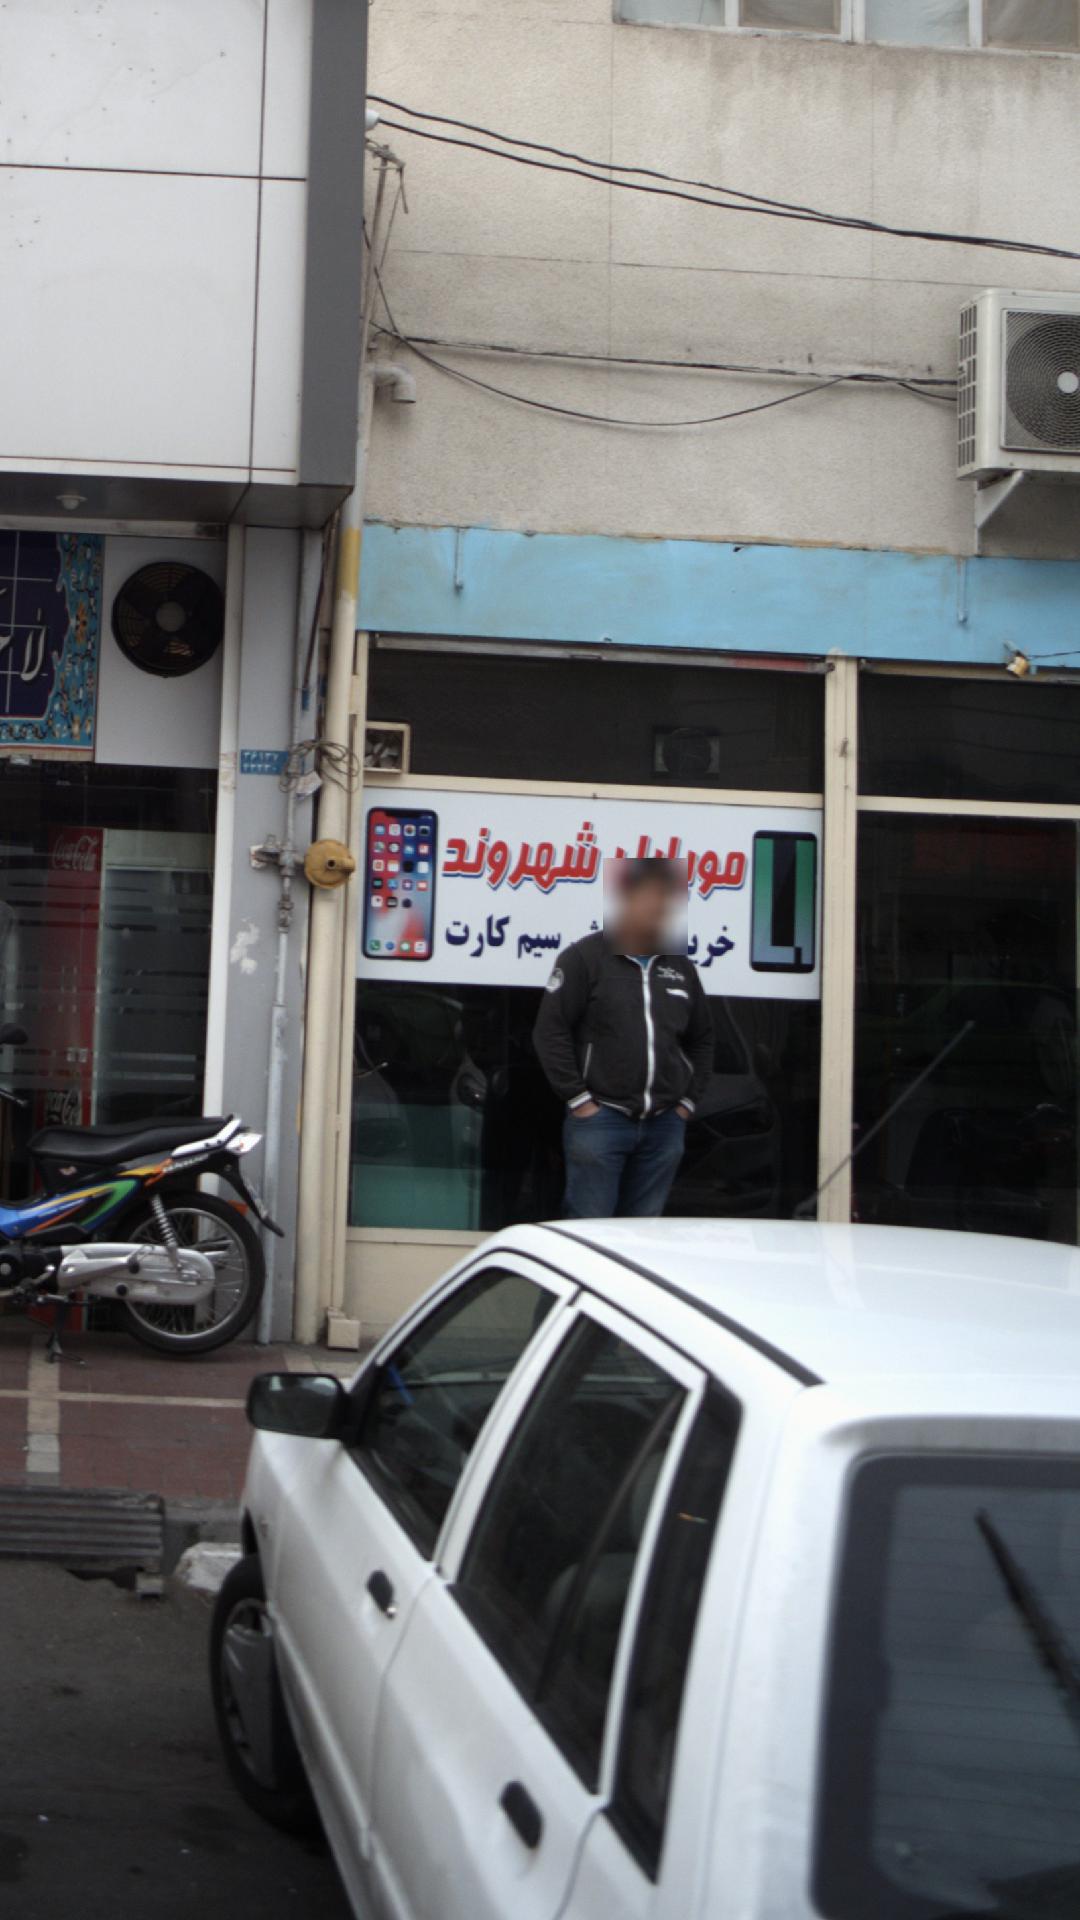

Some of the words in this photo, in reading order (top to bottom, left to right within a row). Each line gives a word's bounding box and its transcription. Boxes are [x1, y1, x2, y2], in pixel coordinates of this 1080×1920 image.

[442, 821, 602, 895] شهروند
[445, 914, 511, 957] کارت
[517, 932, 562, 959] سیم
[687, 924, 736, 967] خری
